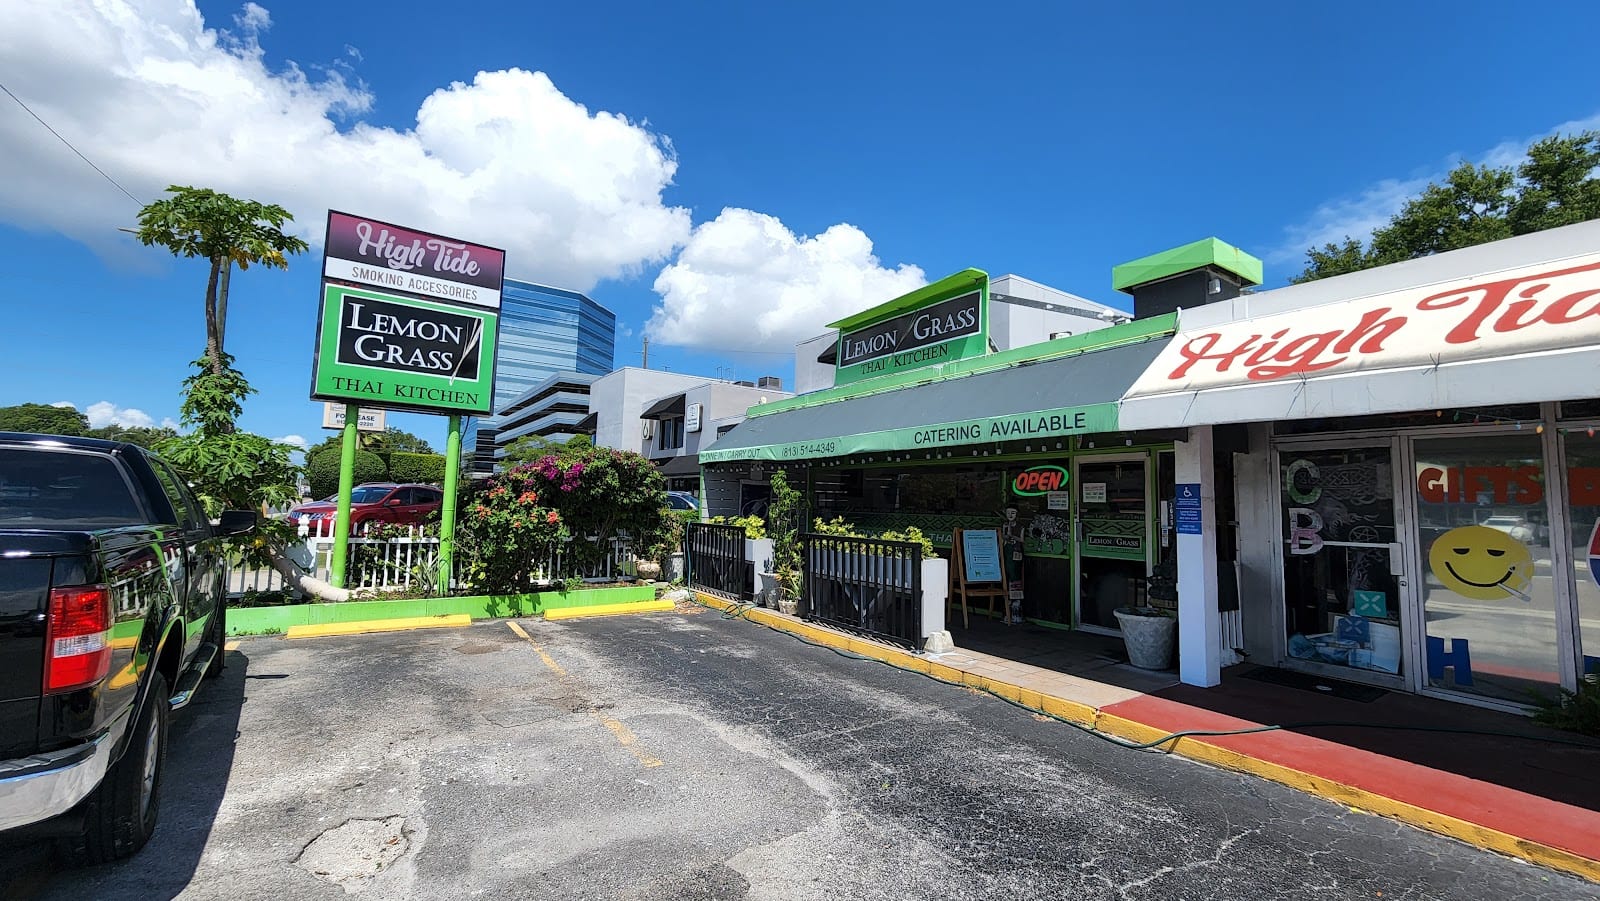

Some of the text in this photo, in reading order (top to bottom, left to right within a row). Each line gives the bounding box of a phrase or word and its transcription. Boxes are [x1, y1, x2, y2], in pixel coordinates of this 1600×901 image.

[356, 222, 480, 278] High Tide
[351, 265, 478, 301] SMOKING ACCESSORIES
[861, 343, 949, 375] THAI KITCHEN
[1168, 307, 1408, 381] High
[332, 376, 480, 405] THAI KITCHEN
[914, 412, 1086, 444] CATERING AVAILABLE
[747, 448, 760, 458] OUT
[800, 442, 835, 456] 514-4349
[1016, 471, 1062, 491] OPEN
[1418, 466, 1543, 505] GIFTS
